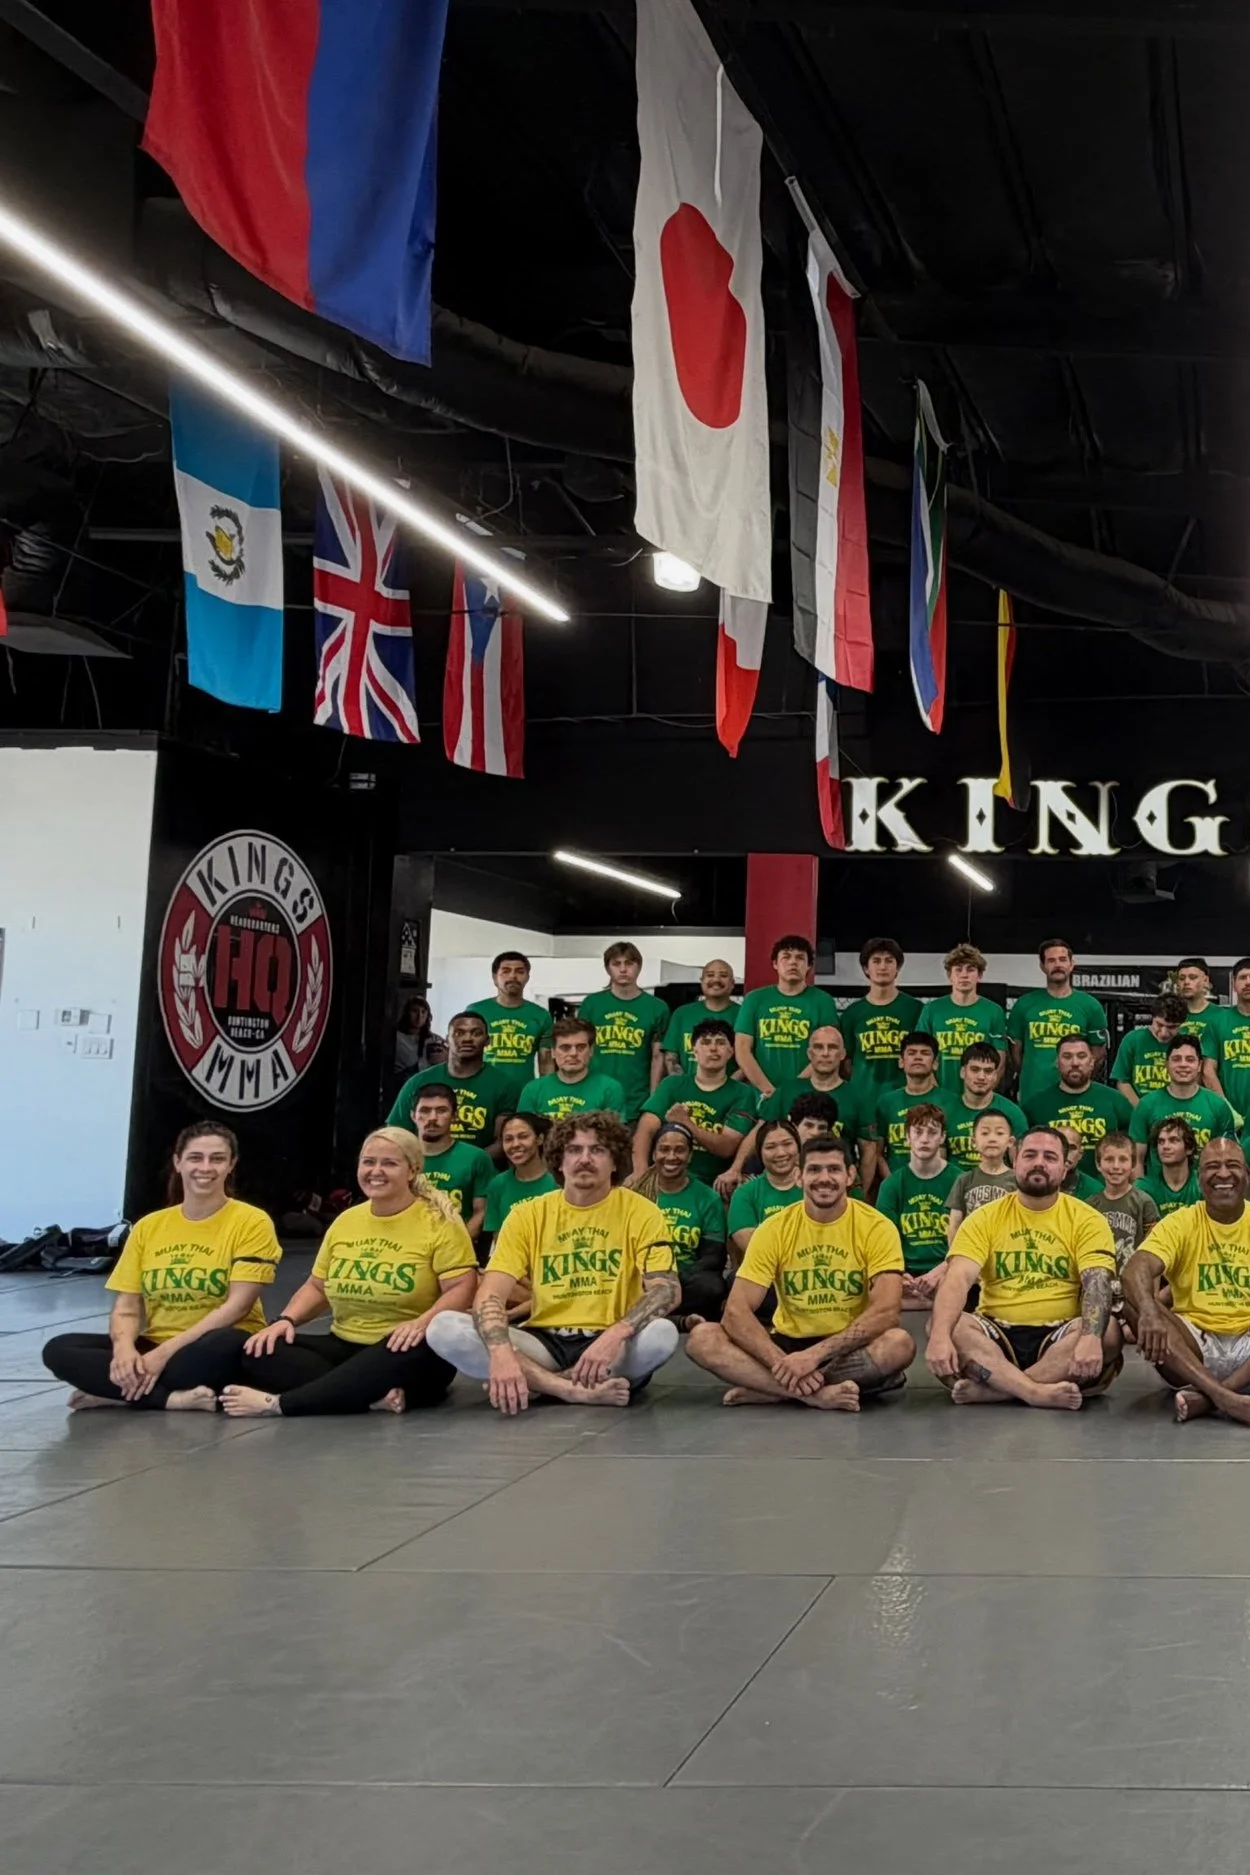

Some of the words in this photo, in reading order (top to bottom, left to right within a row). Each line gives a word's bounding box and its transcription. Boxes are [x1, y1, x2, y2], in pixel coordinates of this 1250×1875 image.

[197, 842, 314, 924] KINGS
[213, 925, 292, 1026] HQ
[1072, 975, 1140, 987] BRAZILIAN
[595, 1026, 644, 1048] KINGS
[759, 1019, 810, 1041] KINGS
[483, 1033, 536, 1055] INGS
[859, 1031, 909, 1051] KING
[205, 1044, 290, 1100] MMA
[1134, 1065, 1171, 1084] KING
[558, 1227, 584, 1243] MUAY
[589, 1228, 609, 1239] THAI
[1035, 1231, 1056, 1244] THAI
[155, 1244, 187, 1257] MUAY
[190, 1244, 214, 1255] THAI
[379, 1239, 402, 1251] THAI
[797, 1245, 823, 1259] MUAY
[826, 1245, 849, 1259] THAI
[1229, 1243, 1250, 1256] THAI
[541, 1249, 623, 1285] KINGS
[994, 1251, 1070, 1279] KINGS
[329, 1258, 416, 1293] INGS
[569, 1277, 597, 1289] MMA
[783, 1269, 864, 1296] KINGS
[160, 1293, 195, 1302] MMA
[337, 1283, 373, 1296] MMA
[808, 1294, 837, 1305] MMA
